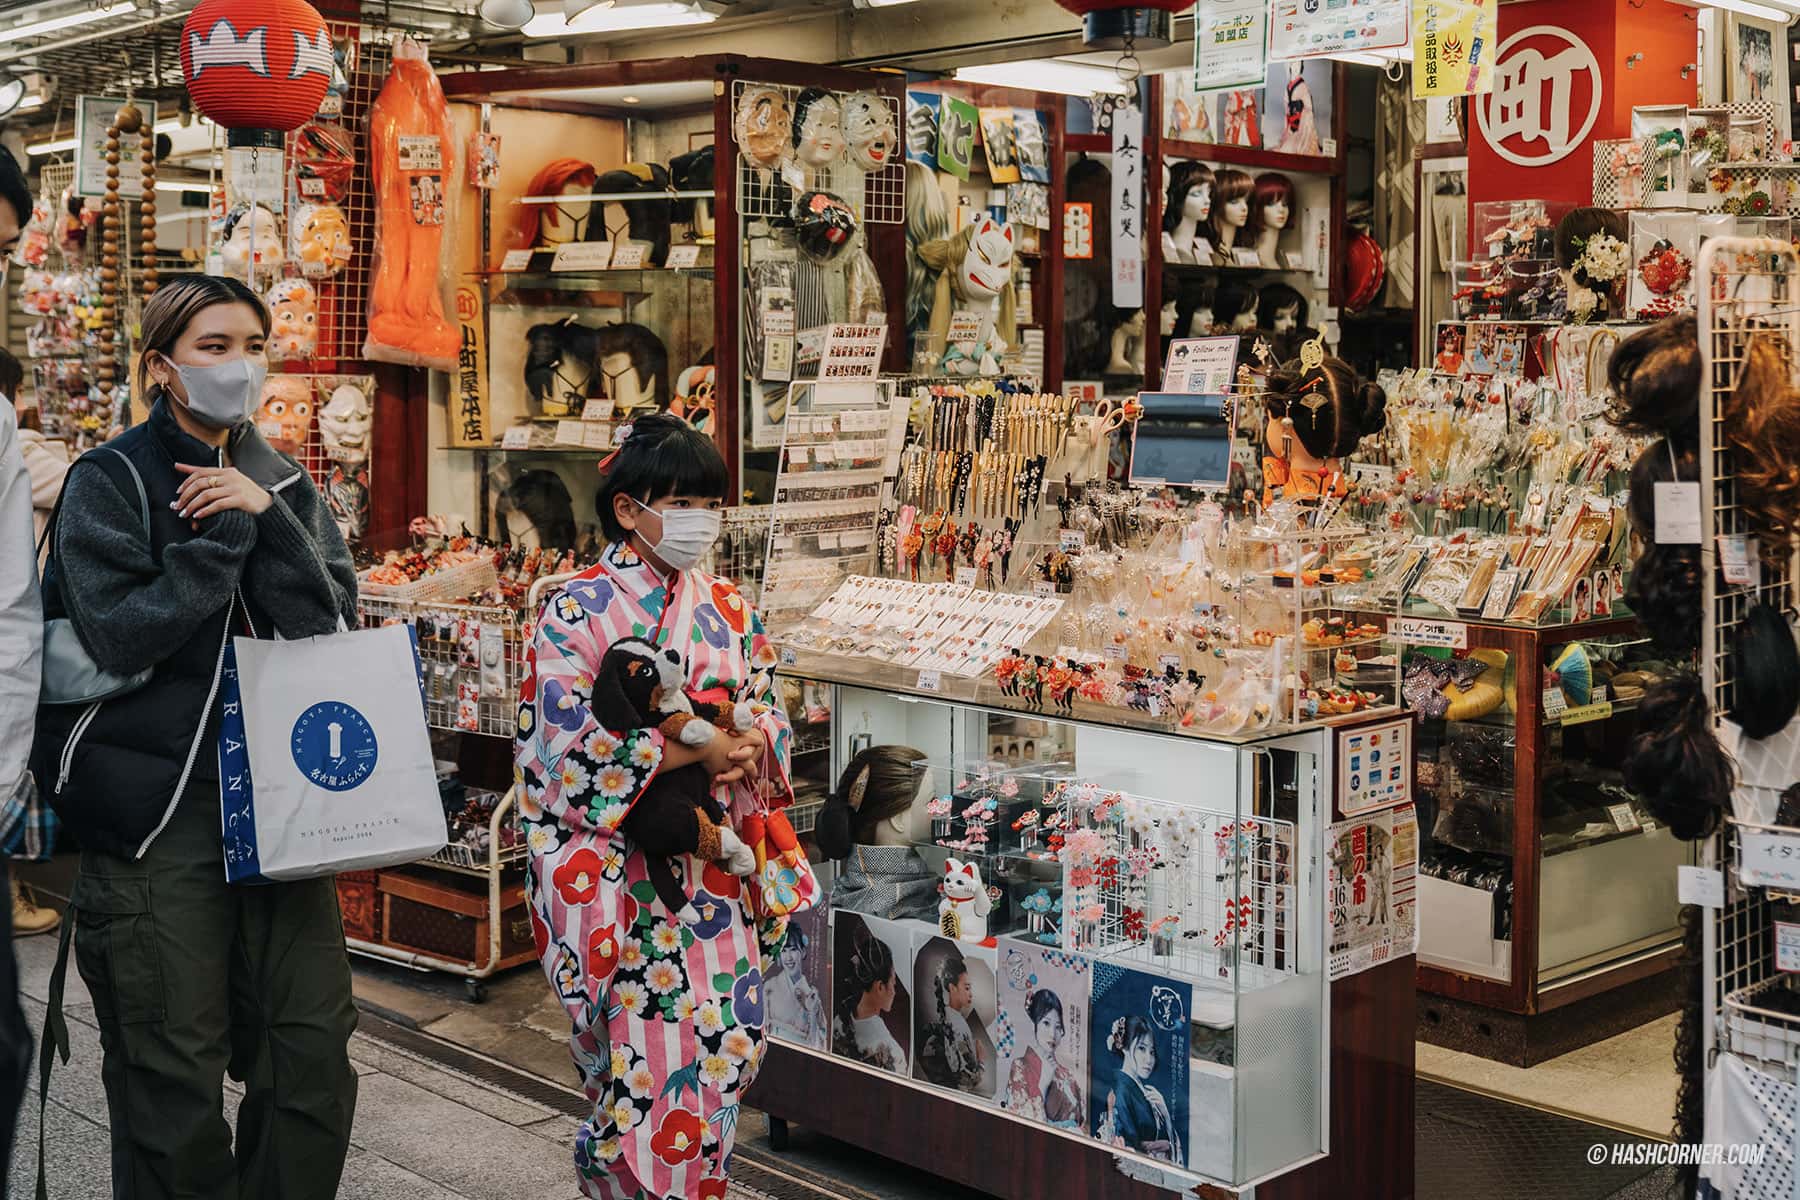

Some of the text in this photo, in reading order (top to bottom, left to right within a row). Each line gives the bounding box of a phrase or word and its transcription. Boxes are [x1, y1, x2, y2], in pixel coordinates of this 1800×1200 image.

[1215, 28, 1249, 43] 加盟店
[296, 705, 372, 754] NAGOYA FRANCE
[223, 666, 243, 864] FRANCE
[310, 762, 367, 787] 名古屋ふらんす
[1334, 885, 1346, 906] 16
[1333, 907, 1347, 928] 28
